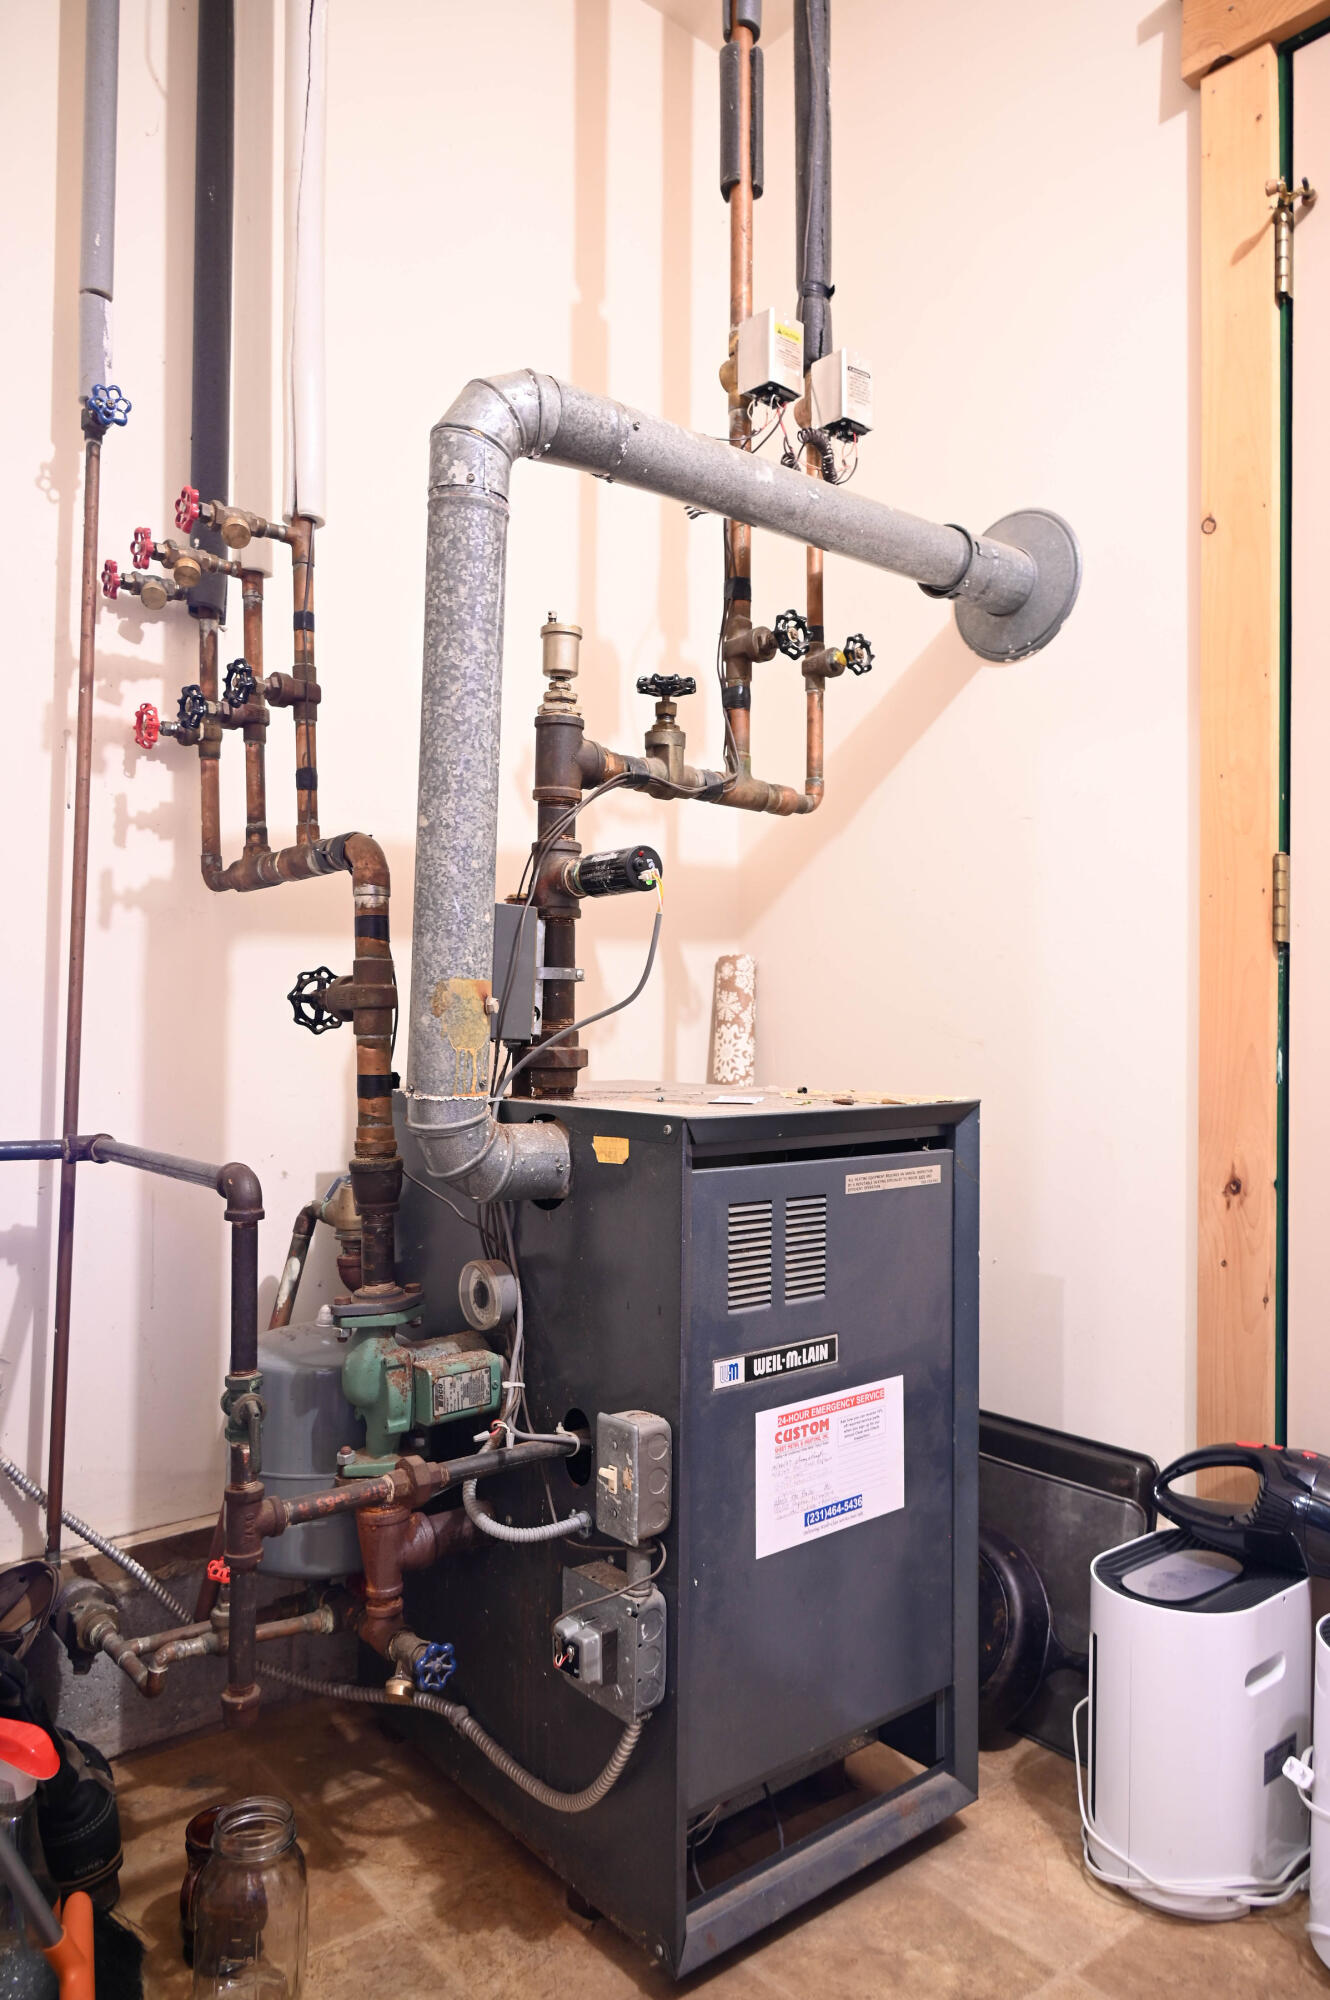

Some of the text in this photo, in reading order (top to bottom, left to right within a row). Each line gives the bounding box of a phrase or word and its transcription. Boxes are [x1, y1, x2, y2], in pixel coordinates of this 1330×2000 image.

[778, 1389, 885, 1426] 24-HOUR EMERGENCY SERVICE
[775, 1418, 830, 1444] CUSTOM
[806, 1496, 862, 1526] (231)464-5436
